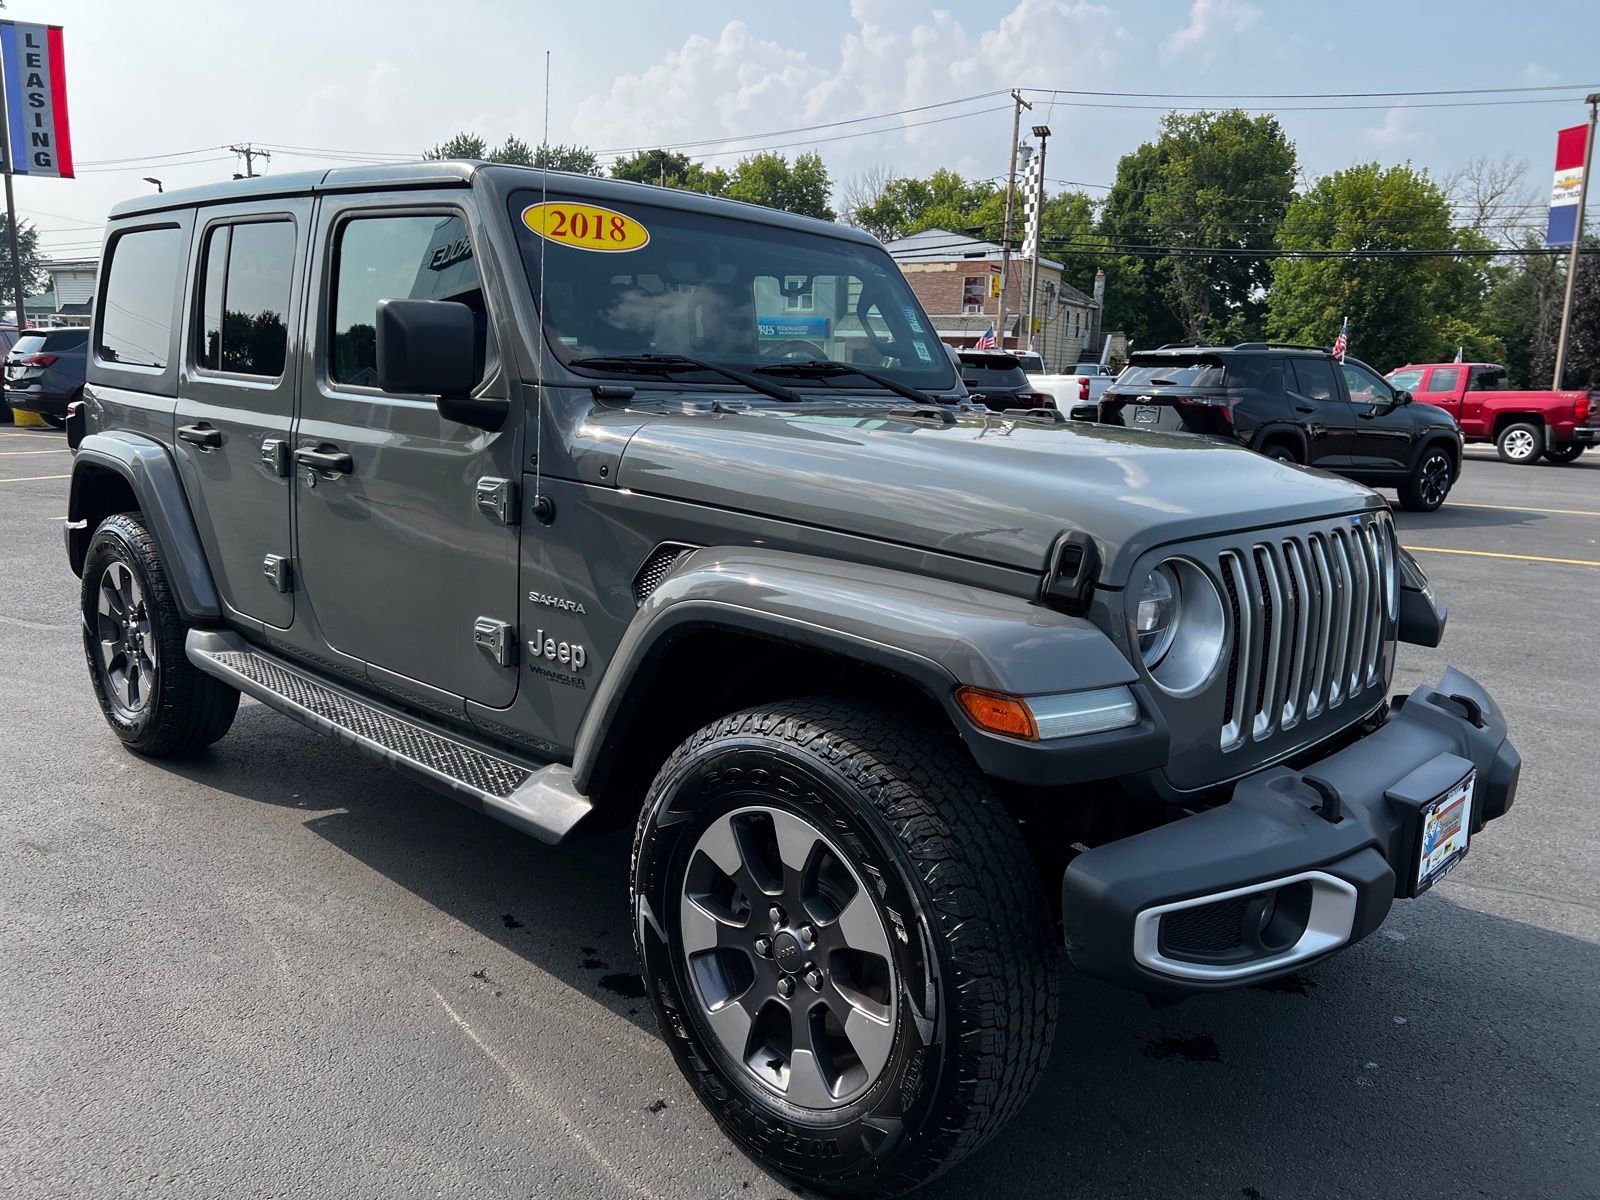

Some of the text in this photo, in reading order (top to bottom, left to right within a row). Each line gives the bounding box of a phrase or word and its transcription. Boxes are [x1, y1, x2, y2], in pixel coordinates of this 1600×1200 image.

[25, 33, 52, 167] LEASING
[550, 210, 626, 243] 2018
[528, 591, 587, 615] SAHARA
[528, 629, 586, 672] Jeep
[529, 664, 585, 685] WRANGLER
